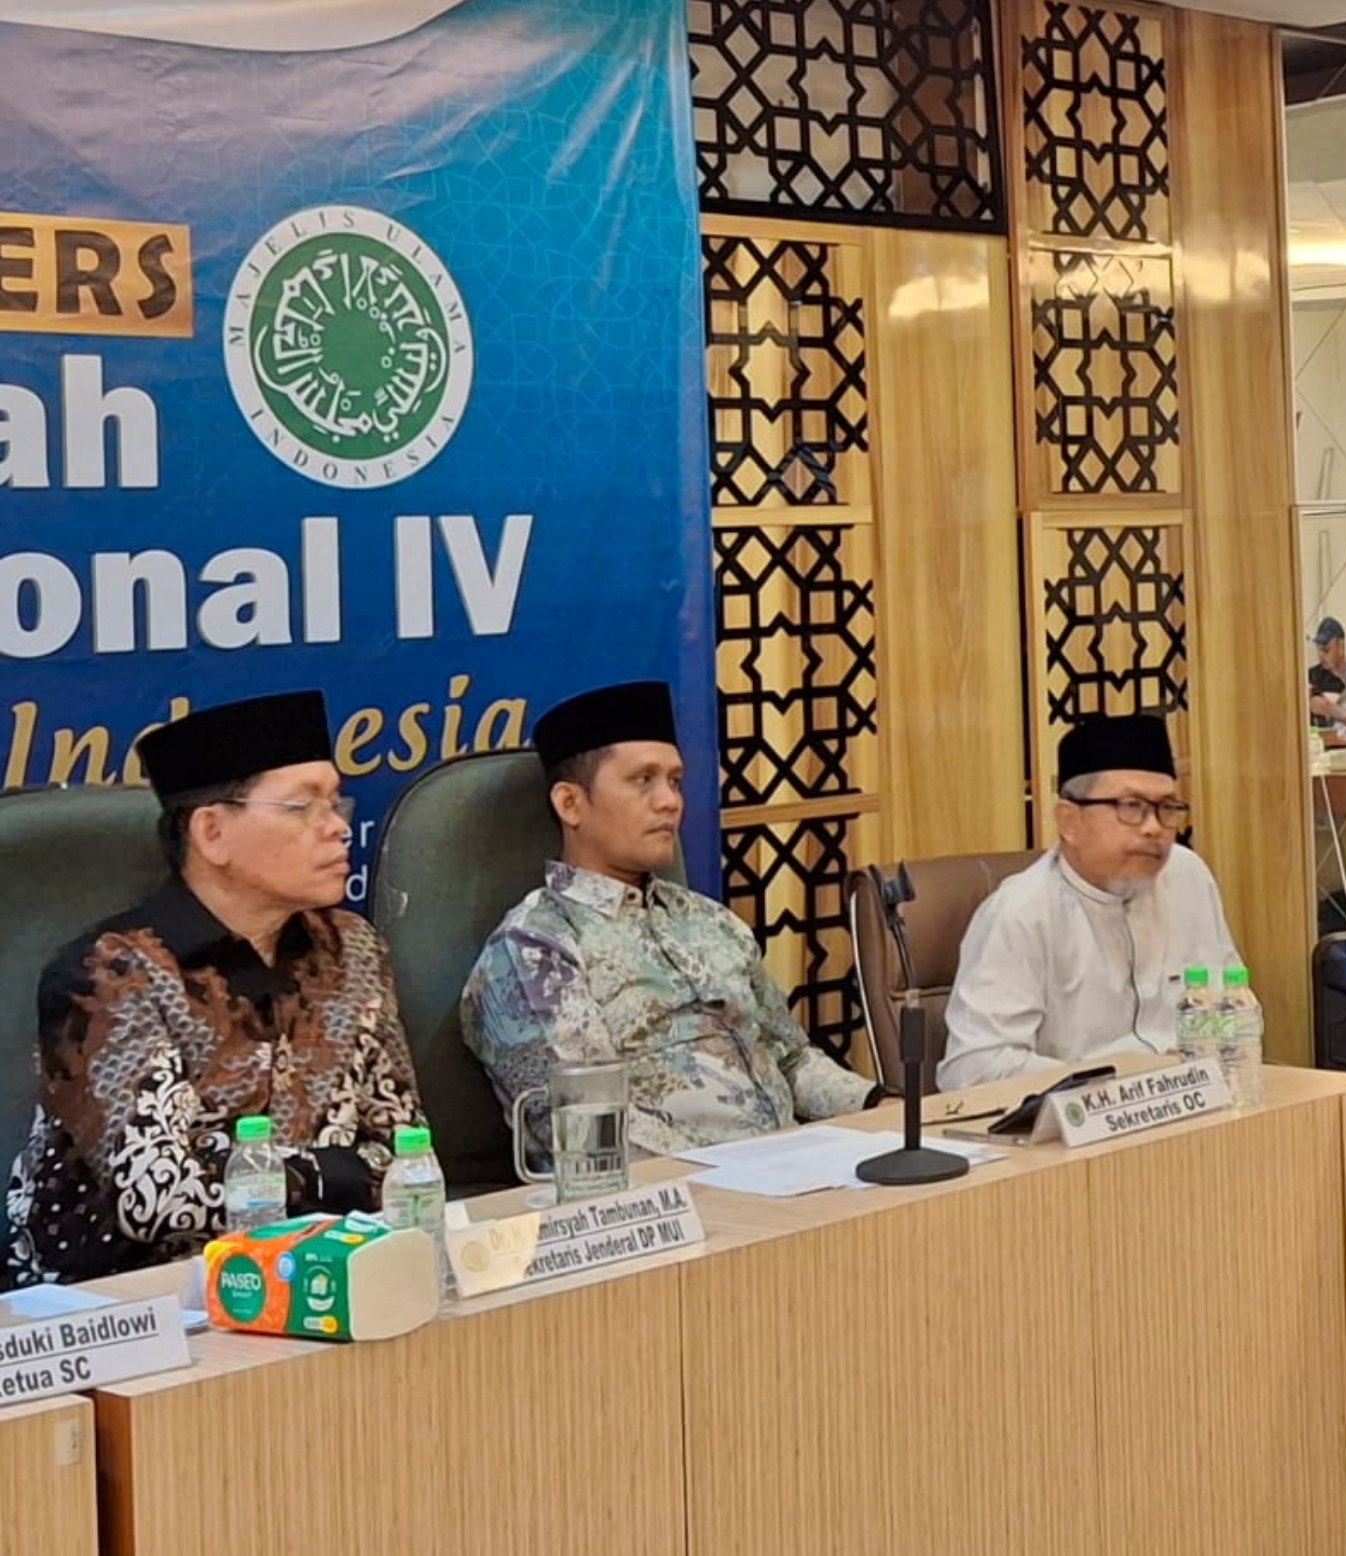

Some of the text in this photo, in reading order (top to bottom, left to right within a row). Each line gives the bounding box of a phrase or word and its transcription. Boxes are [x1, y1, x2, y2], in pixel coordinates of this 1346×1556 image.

[228, 211, 468, 355] MAJELIS ULAMA
[250, 407, 457, 484] INDONESIA
[393, 514, 533, 638] IV
[1082, 1066, 1210, 1112] K.H. Arif Fahrudin
[1106, 1091, 1207, 1132] Sekretaris OC
[588, 1199, 661, 1227] Tambunan,
[585, 1229, 639, 1262] Jenderal
[637, 1225, 656, 1249] DP
[656, 1219, 685, 1244] MUI
[221, 1271, 262, 1290] PASEO
[59, 1306, 157, 1348] Baidlowi
[0, 1355, 92, 1398] etua SC
